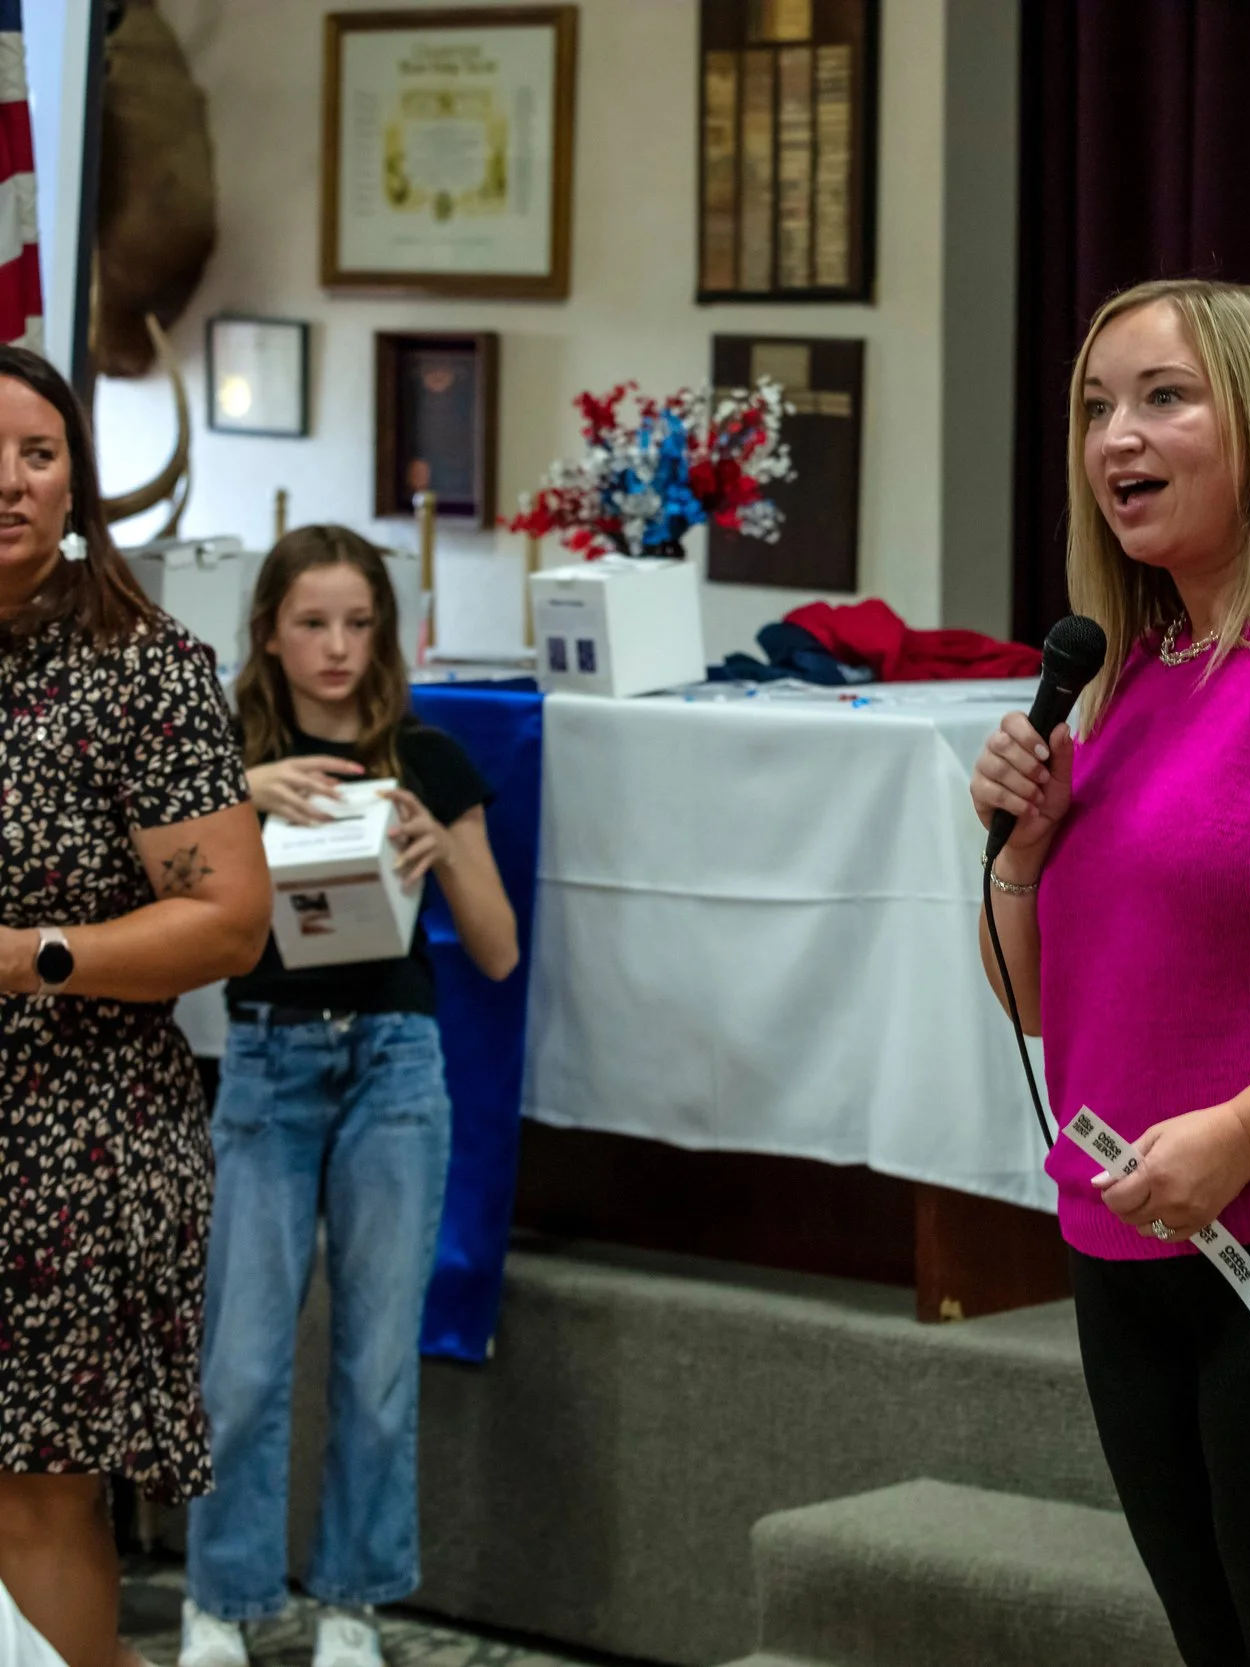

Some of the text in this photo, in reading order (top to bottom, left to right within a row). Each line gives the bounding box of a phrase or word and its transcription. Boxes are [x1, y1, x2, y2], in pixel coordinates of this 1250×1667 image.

[1092, 1139, 1117, 1162] DEPOT
[1098, 1132, 1122, 1156] Office
[1218, 1250, 1247, 1284] DEPOT
